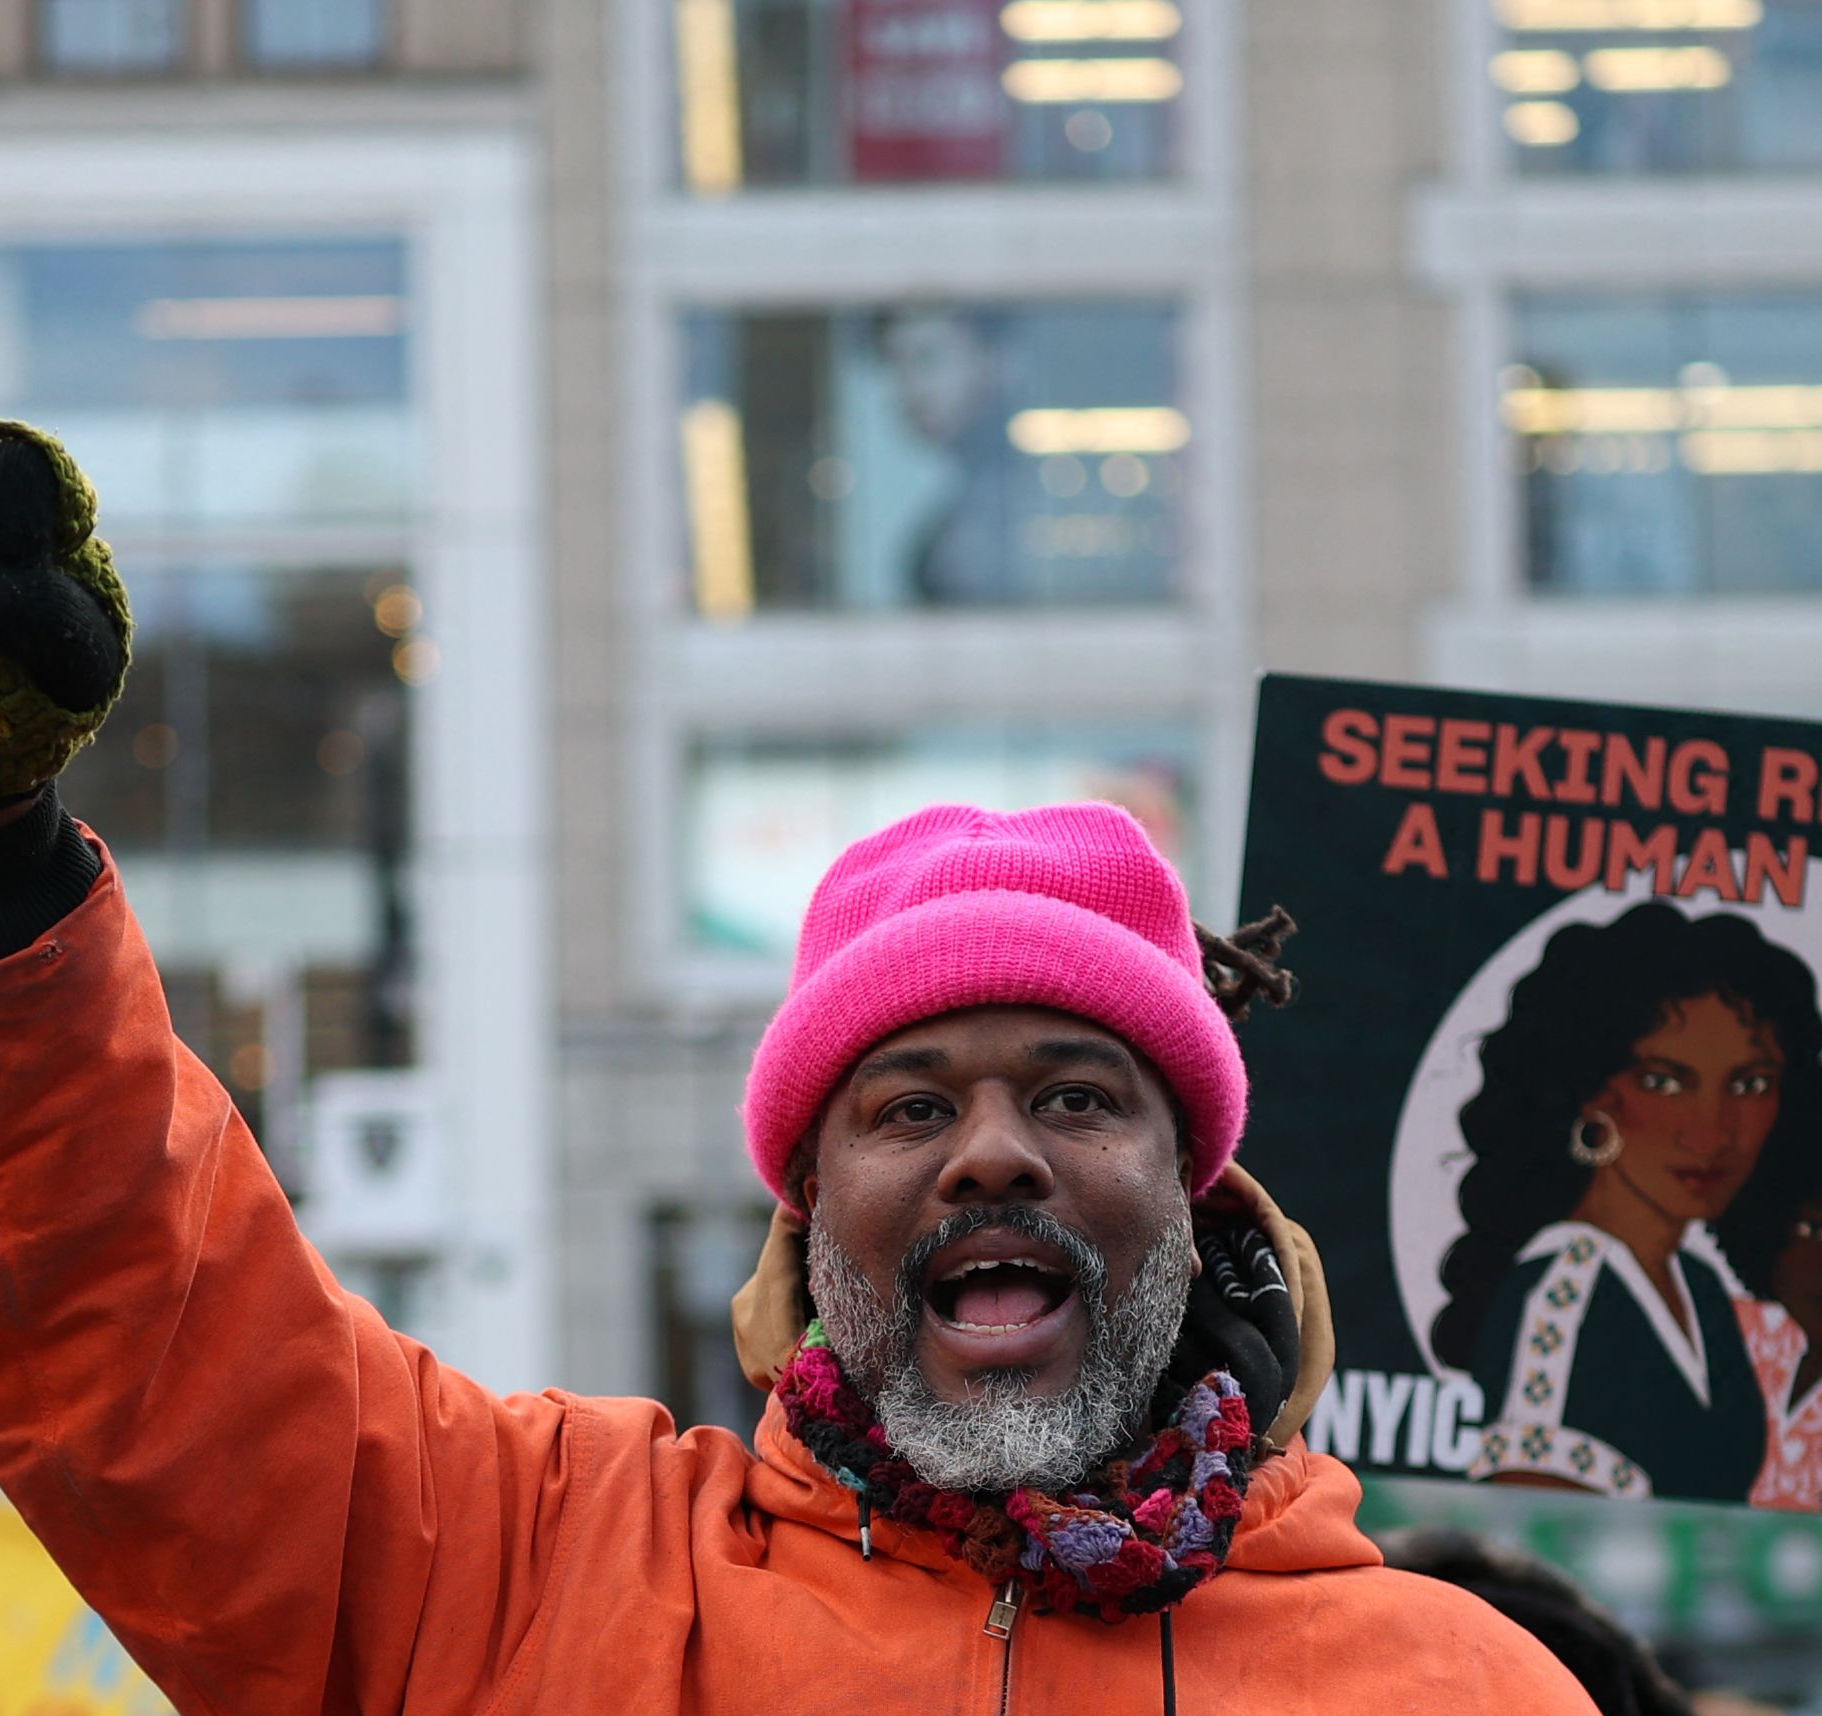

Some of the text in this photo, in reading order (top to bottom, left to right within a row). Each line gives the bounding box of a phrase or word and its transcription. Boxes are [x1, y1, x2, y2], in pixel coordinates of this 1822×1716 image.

[1319, 709, 1728, 814] SEEKING
[1384, 804, 1447, 877] A
[1478, 810, 1806, 906] HUMAN
[1308, 1367, 1487, 1474] NYIC
